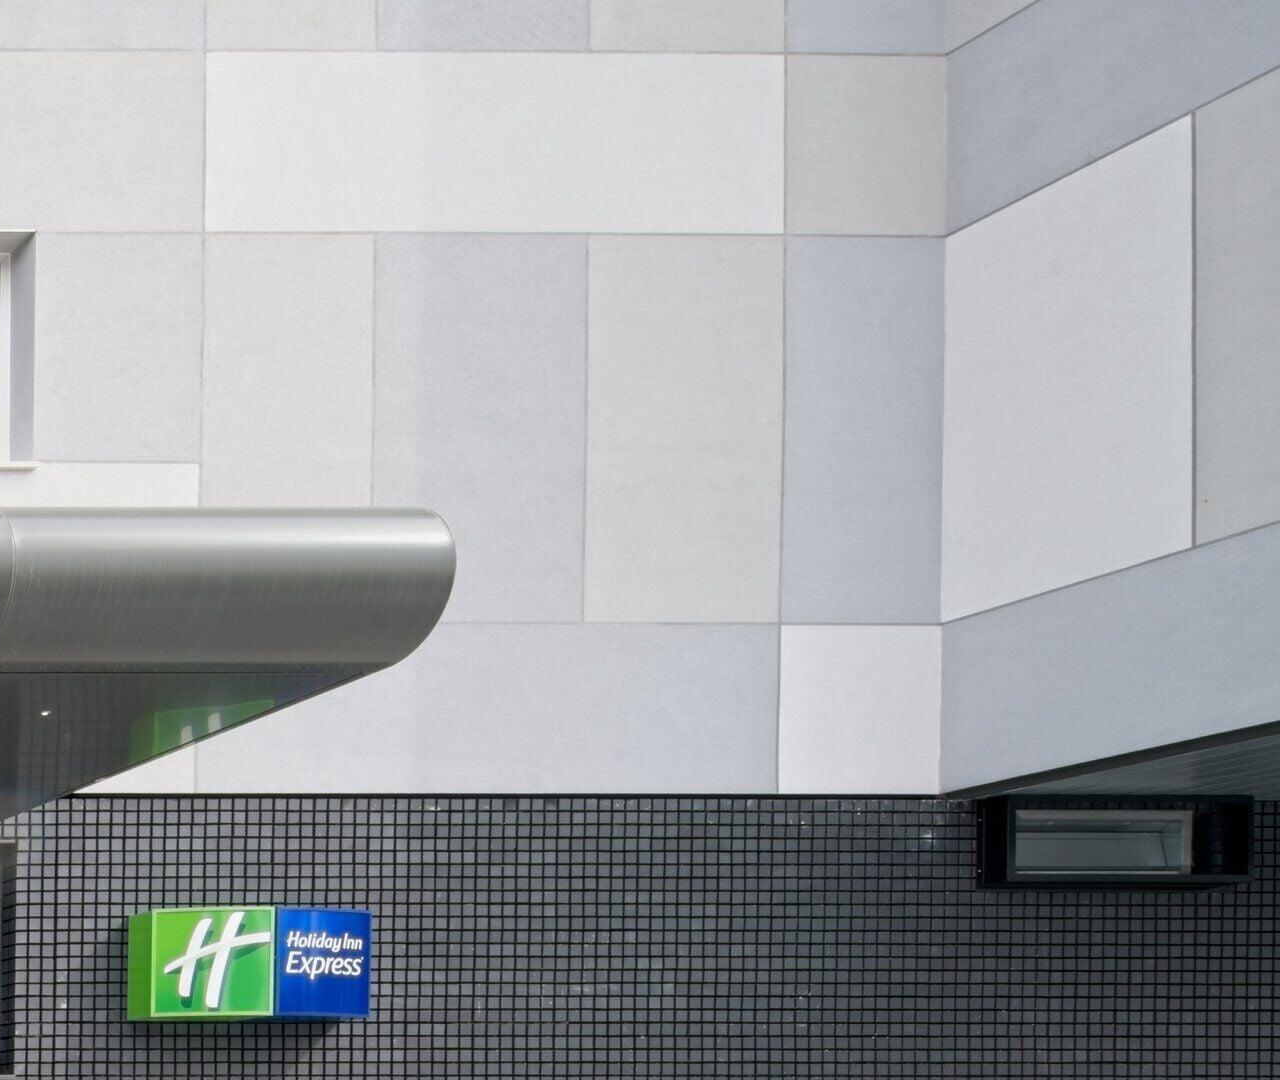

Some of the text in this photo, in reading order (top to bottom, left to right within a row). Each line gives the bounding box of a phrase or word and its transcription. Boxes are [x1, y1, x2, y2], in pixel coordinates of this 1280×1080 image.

[286, 931, 363, 952] Holiday Inn
[285, 951, 362, 980] Express
